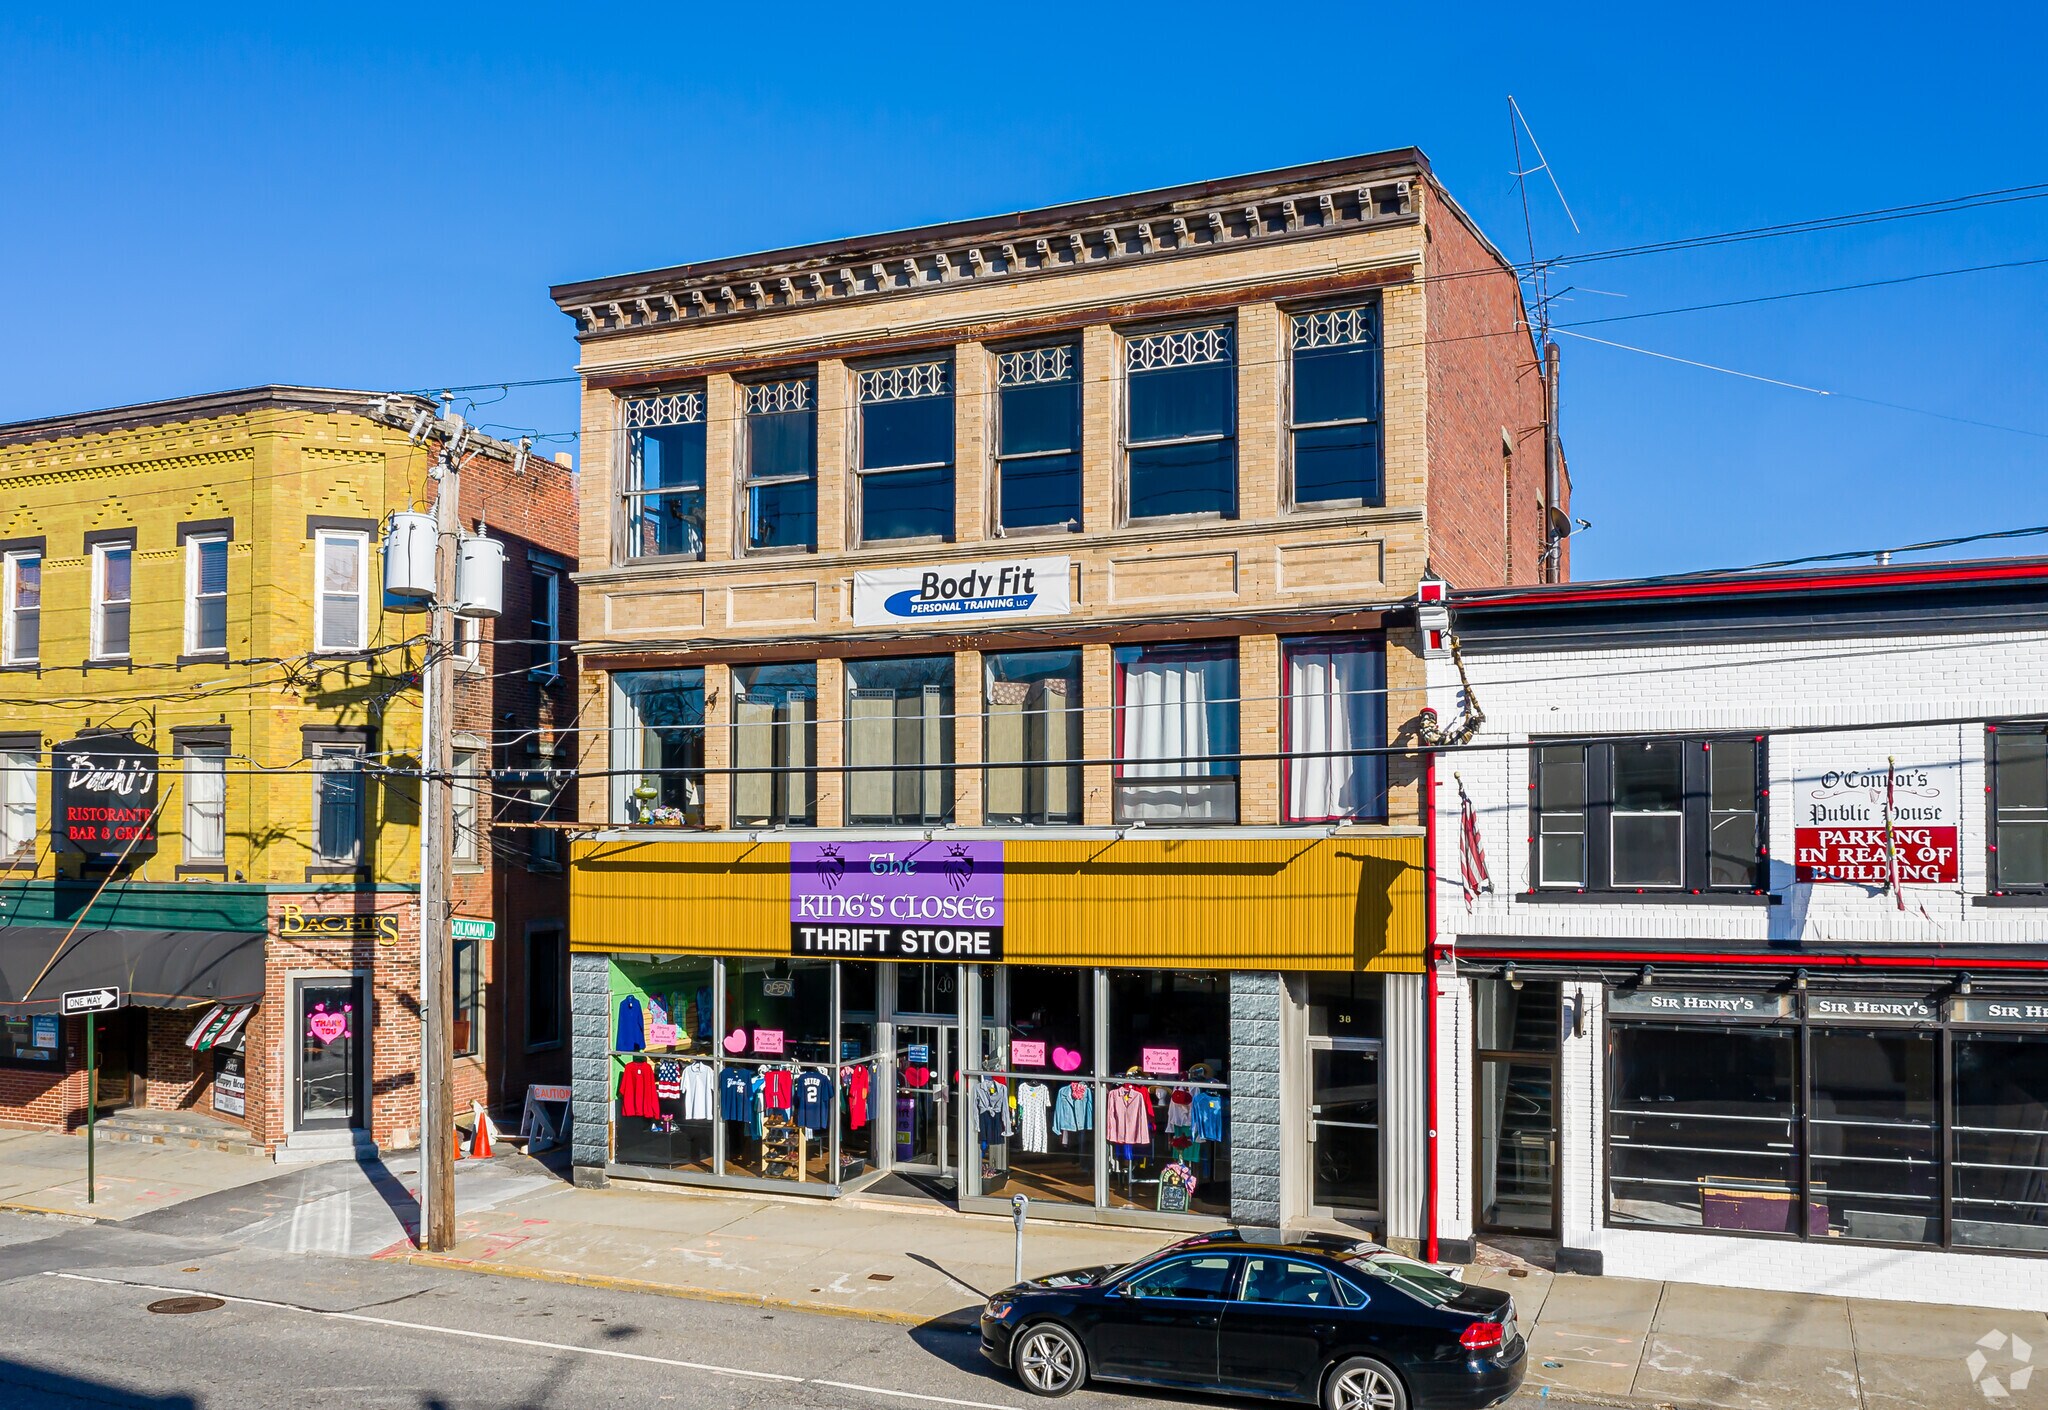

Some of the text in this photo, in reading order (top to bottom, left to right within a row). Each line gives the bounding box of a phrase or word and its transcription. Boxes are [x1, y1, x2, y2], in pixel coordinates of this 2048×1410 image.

[920, 565, 1035, 600] Body Fit
[911, 602, 961, 614] PERSONAL
[1016, 599, 1028, 607] LLC
[66, 752, 155, 795] Bachi's
[1809, 803, 1871, 826] Public
[69, 826, 97, 840] BAR
[101, 825, 111, 840] &
[1818, 829, 1933, 849] PARKNG
[868, 852, 918, 877] The
[1798, 847, 1953, 866] IN REAR OF
[1811, 865, 1941, 883] BUILDNG
[890, 893, 996, 920] CLOSET
[280, 903, 399, 947] BACHI'S
[800, 927, 991, 955] THRIFT STORE
[764, 983, 790, 993] OPEN
[937, 976, 954, 993] 40
[70, 995, 102, 1007] ONE WAY
[1651, 996, 1680, 1010] SIR
[1819, 1001, 1850, 1014] SIR
[1339, 1014, 1351, 1024] 38
[1988, 1004, 2022, 1019] SIR
[315, 1019, 342, 1027] THANK
[806, 1086, 818, 1103] 2
